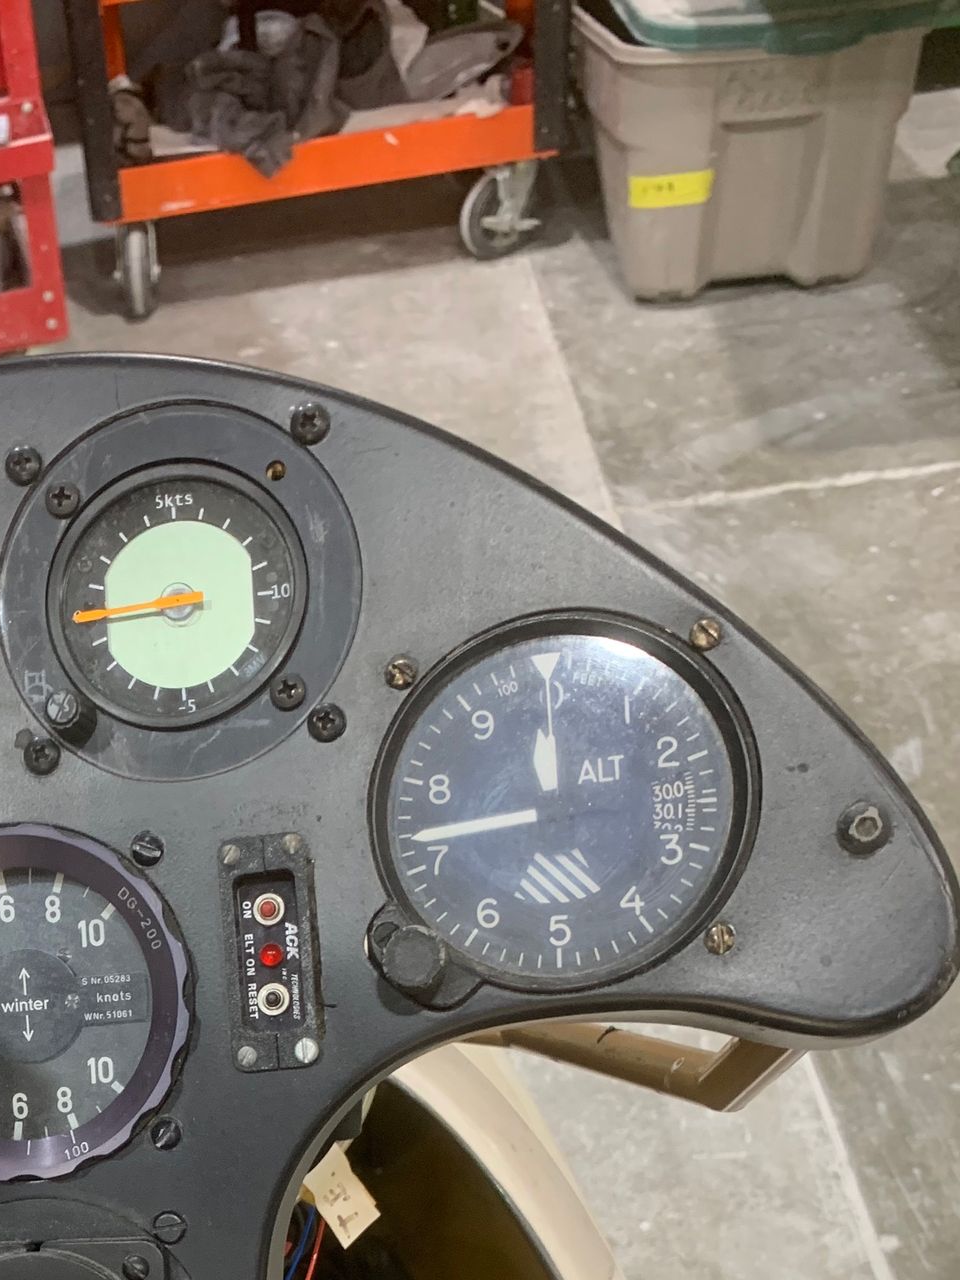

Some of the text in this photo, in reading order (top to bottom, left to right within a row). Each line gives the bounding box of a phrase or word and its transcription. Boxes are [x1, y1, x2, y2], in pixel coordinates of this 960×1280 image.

[155, 493, 193, 509] 5kts
[471, 710, 494, 740] 9
[656, 736, 679, 768] 2
[578, 755, 624, 784] ALT
[429, 774, 450, 804] 8
[652, 781, 684, 802] 30.0
[652, 803, 682, 820] 30.1
[426, 845, 449, 875] 7
[660, 833, 683, 865] 3
[44, 895, 61, 923] 8
[242, 901, 252, 919] ON
[476, 898, 500, 928] 6
[620, 885, 644, 915] 4
[77, 919, 105, 948] 10
[284, 922, 300, 960] ACK
[549, 915, 571, 946] 5
[244, 933, 256, 977] ELT ON
[1, 997, 50, 1015] winter
[96, 991, 132, 1003] knots
[247, 982, 259, 1020] RESET
[87, 1056, 114, 1084] 10
[12, 1092, 28, 1120] 6
[57, 1086, 73, 1113] 8
[64, 1142, 89, 1160] 100
